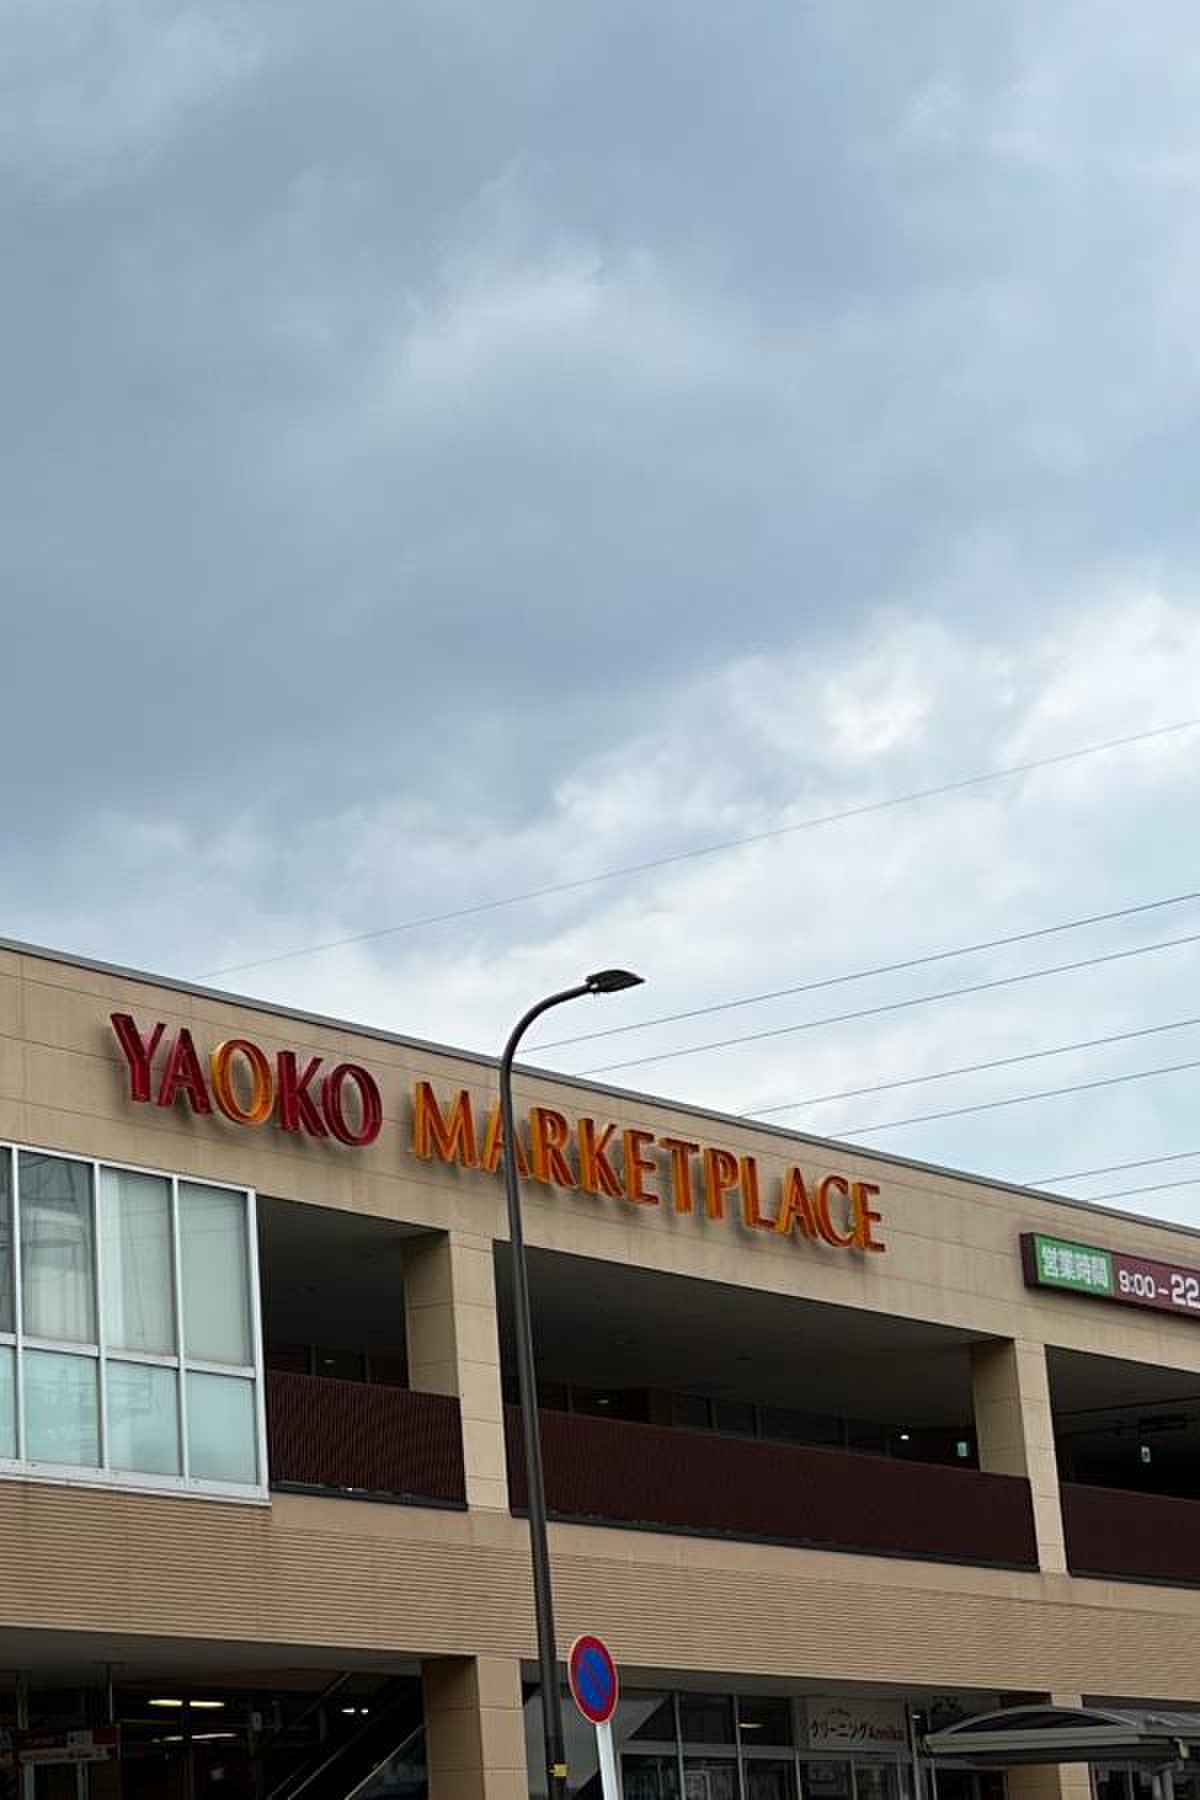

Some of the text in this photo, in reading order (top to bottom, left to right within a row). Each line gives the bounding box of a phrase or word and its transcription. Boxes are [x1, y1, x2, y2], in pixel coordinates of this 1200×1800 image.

[109, 1012, 886, 1253] YAOKO MARKETPLACE
[1040, 1247, 1109, 1289] 営業時間
